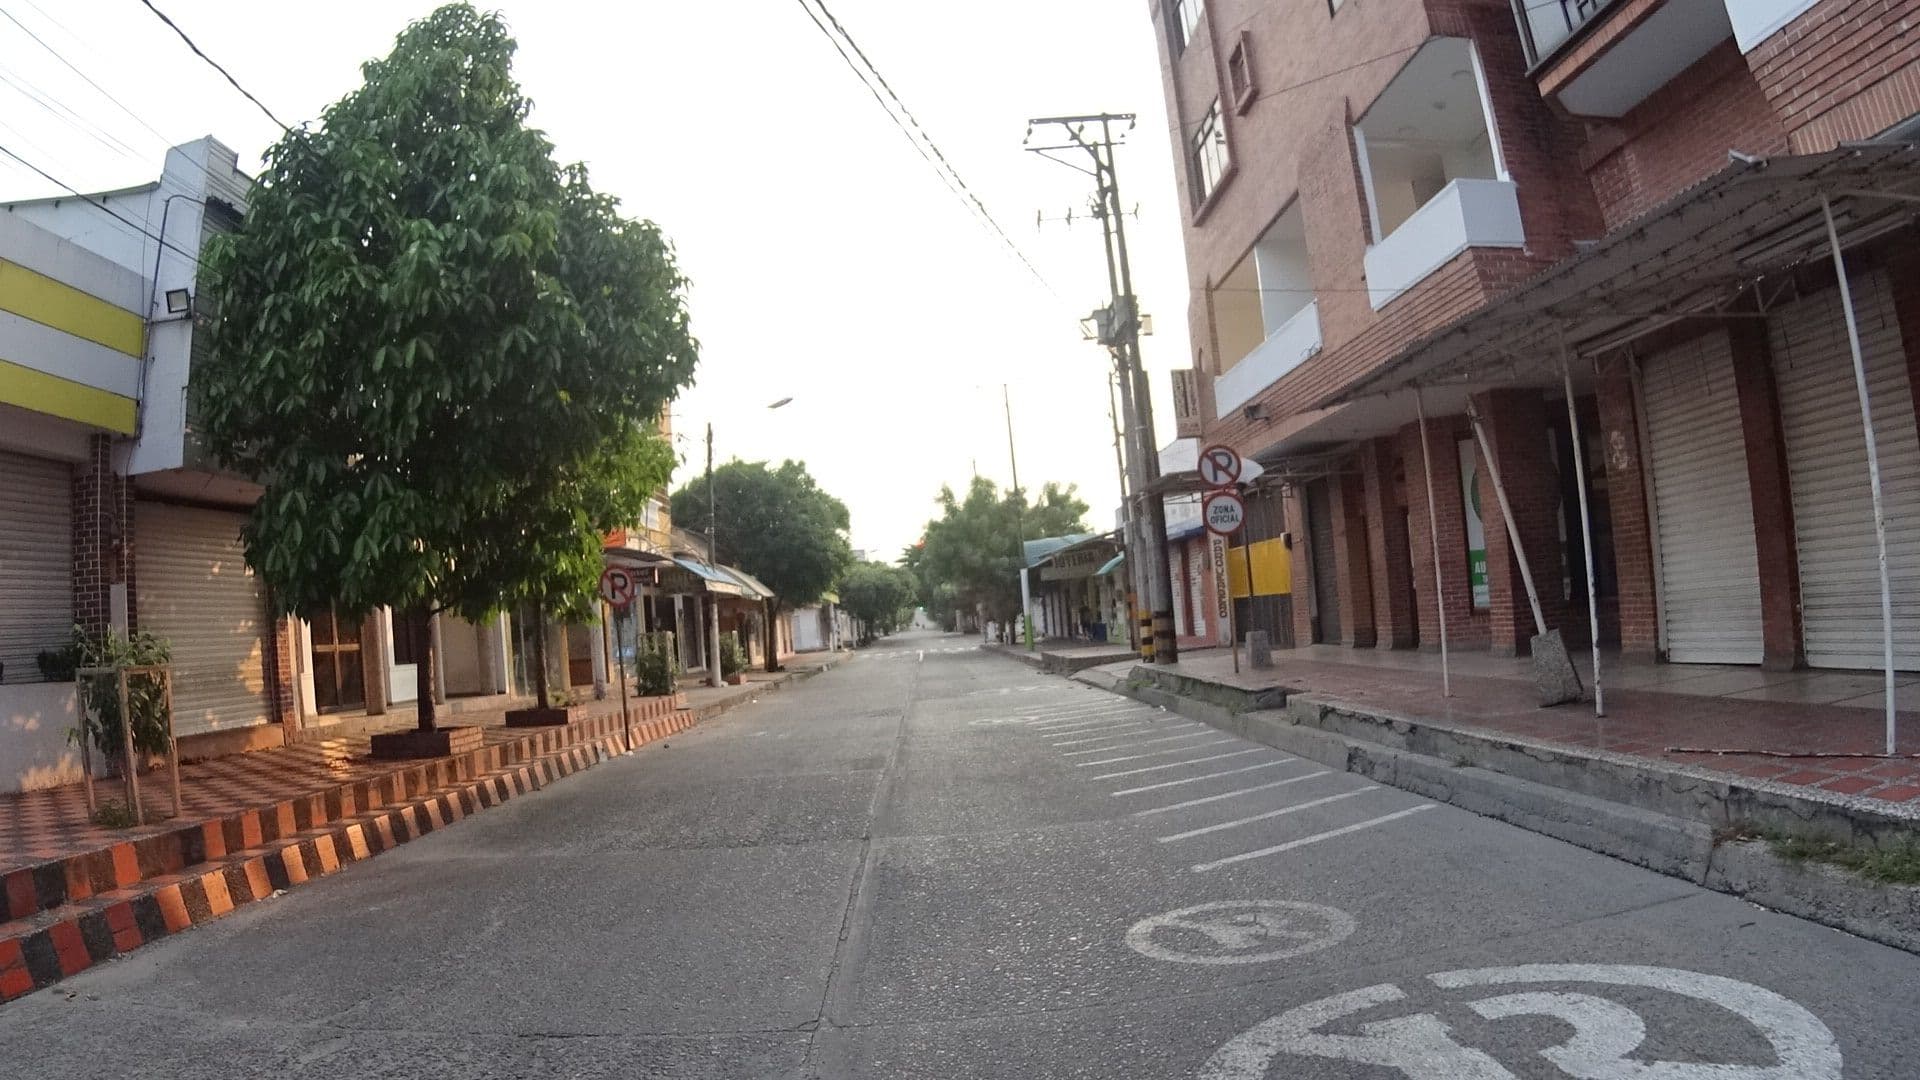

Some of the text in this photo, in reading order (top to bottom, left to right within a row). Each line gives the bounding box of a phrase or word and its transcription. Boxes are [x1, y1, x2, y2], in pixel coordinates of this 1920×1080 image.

[1211, 452, 1232, 481] P
[1213, 504, 1235, 514] ZONA
[1210, 514, 1239, 523] OFICIAL
[611, 573, 627, 599] P
